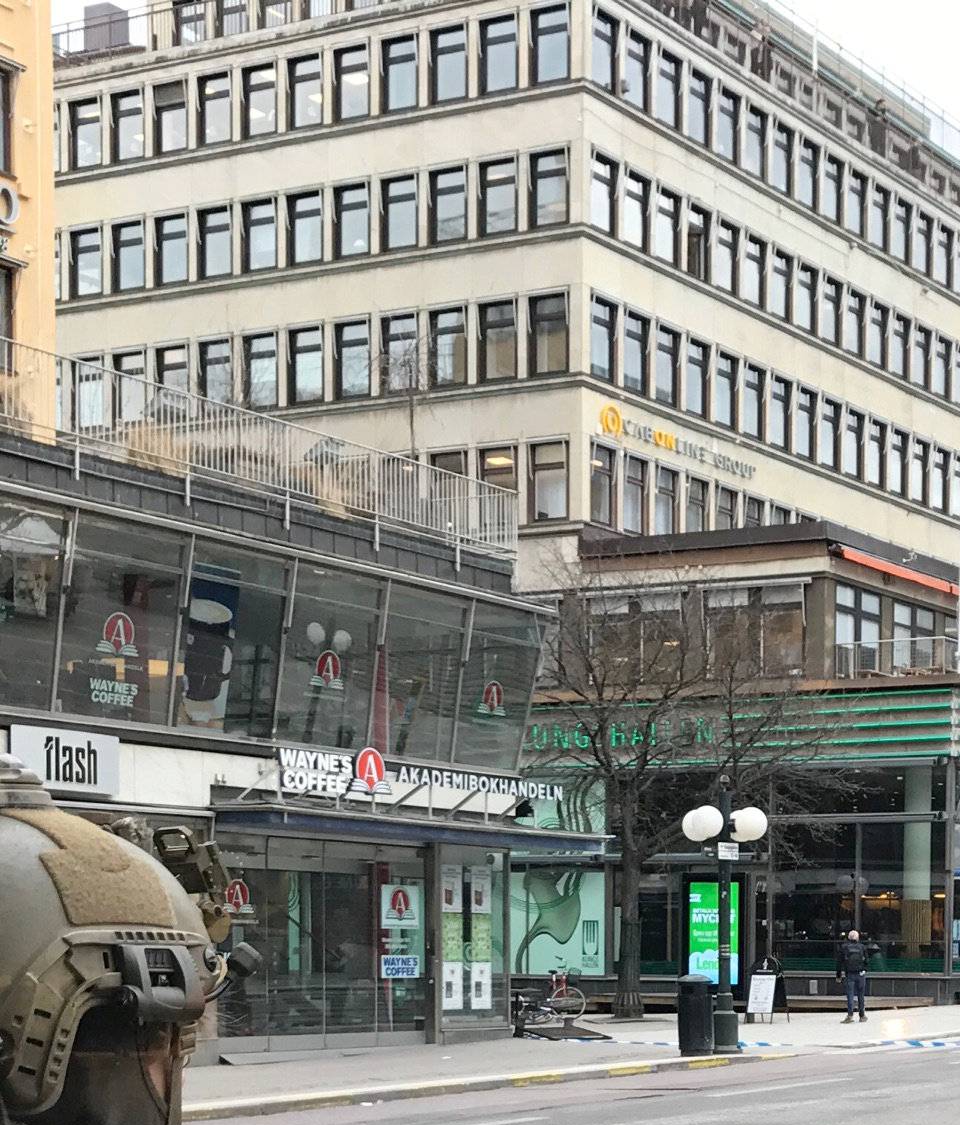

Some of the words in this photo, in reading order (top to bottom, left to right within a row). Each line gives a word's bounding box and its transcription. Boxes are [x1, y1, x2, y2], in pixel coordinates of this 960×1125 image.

[91, 690, 134, 708] COFFEE
[44, 735, 97, 785] flash
[280, 748, 353, 773] WAYNE'S
[283, 770, 350, 794] COFFEE
[398, 765, 564, 801] AKADEMIBOKHANDELN
[385, 966, 416, 977] COFFEE
